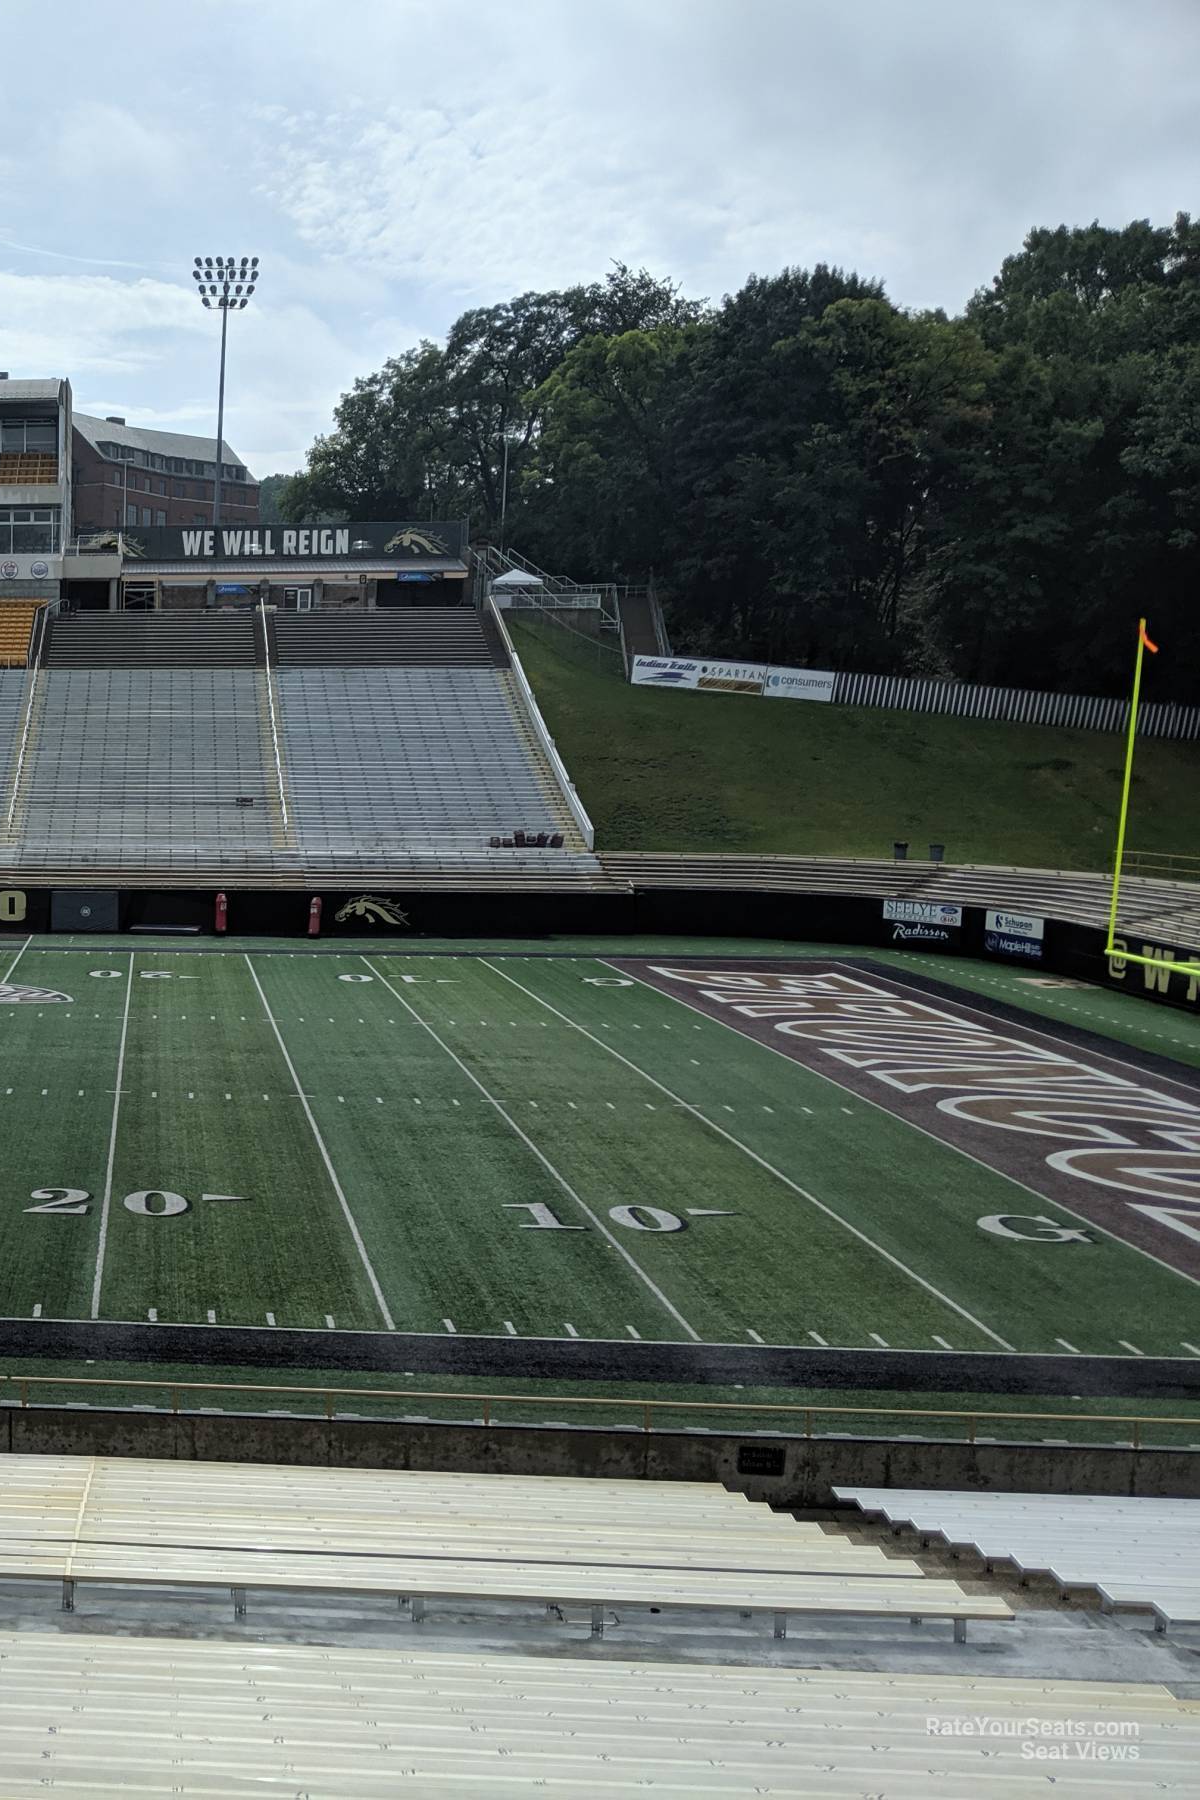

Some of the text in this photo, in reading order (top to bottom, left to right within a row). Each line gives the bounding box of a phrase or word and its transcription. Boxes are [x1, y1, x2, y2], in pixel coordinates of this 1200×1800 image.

[182, 529, 349, 556] WE WILL REIGN
[636, 658, 698, 672] Indian Trails
[710, 666, 766, 681] SPARTAN
[780, 675, 833, 689] consumers
[886, 901, 938, 917] SEELYE
[1004, 915, 1033, 930] Schupan
[892, 923, 949, 940] Radisson
[22, 1186, 190, 1217] 20
[501, 1201, 688, 1233] 10
[976, 1213, 1094, 1243] G
